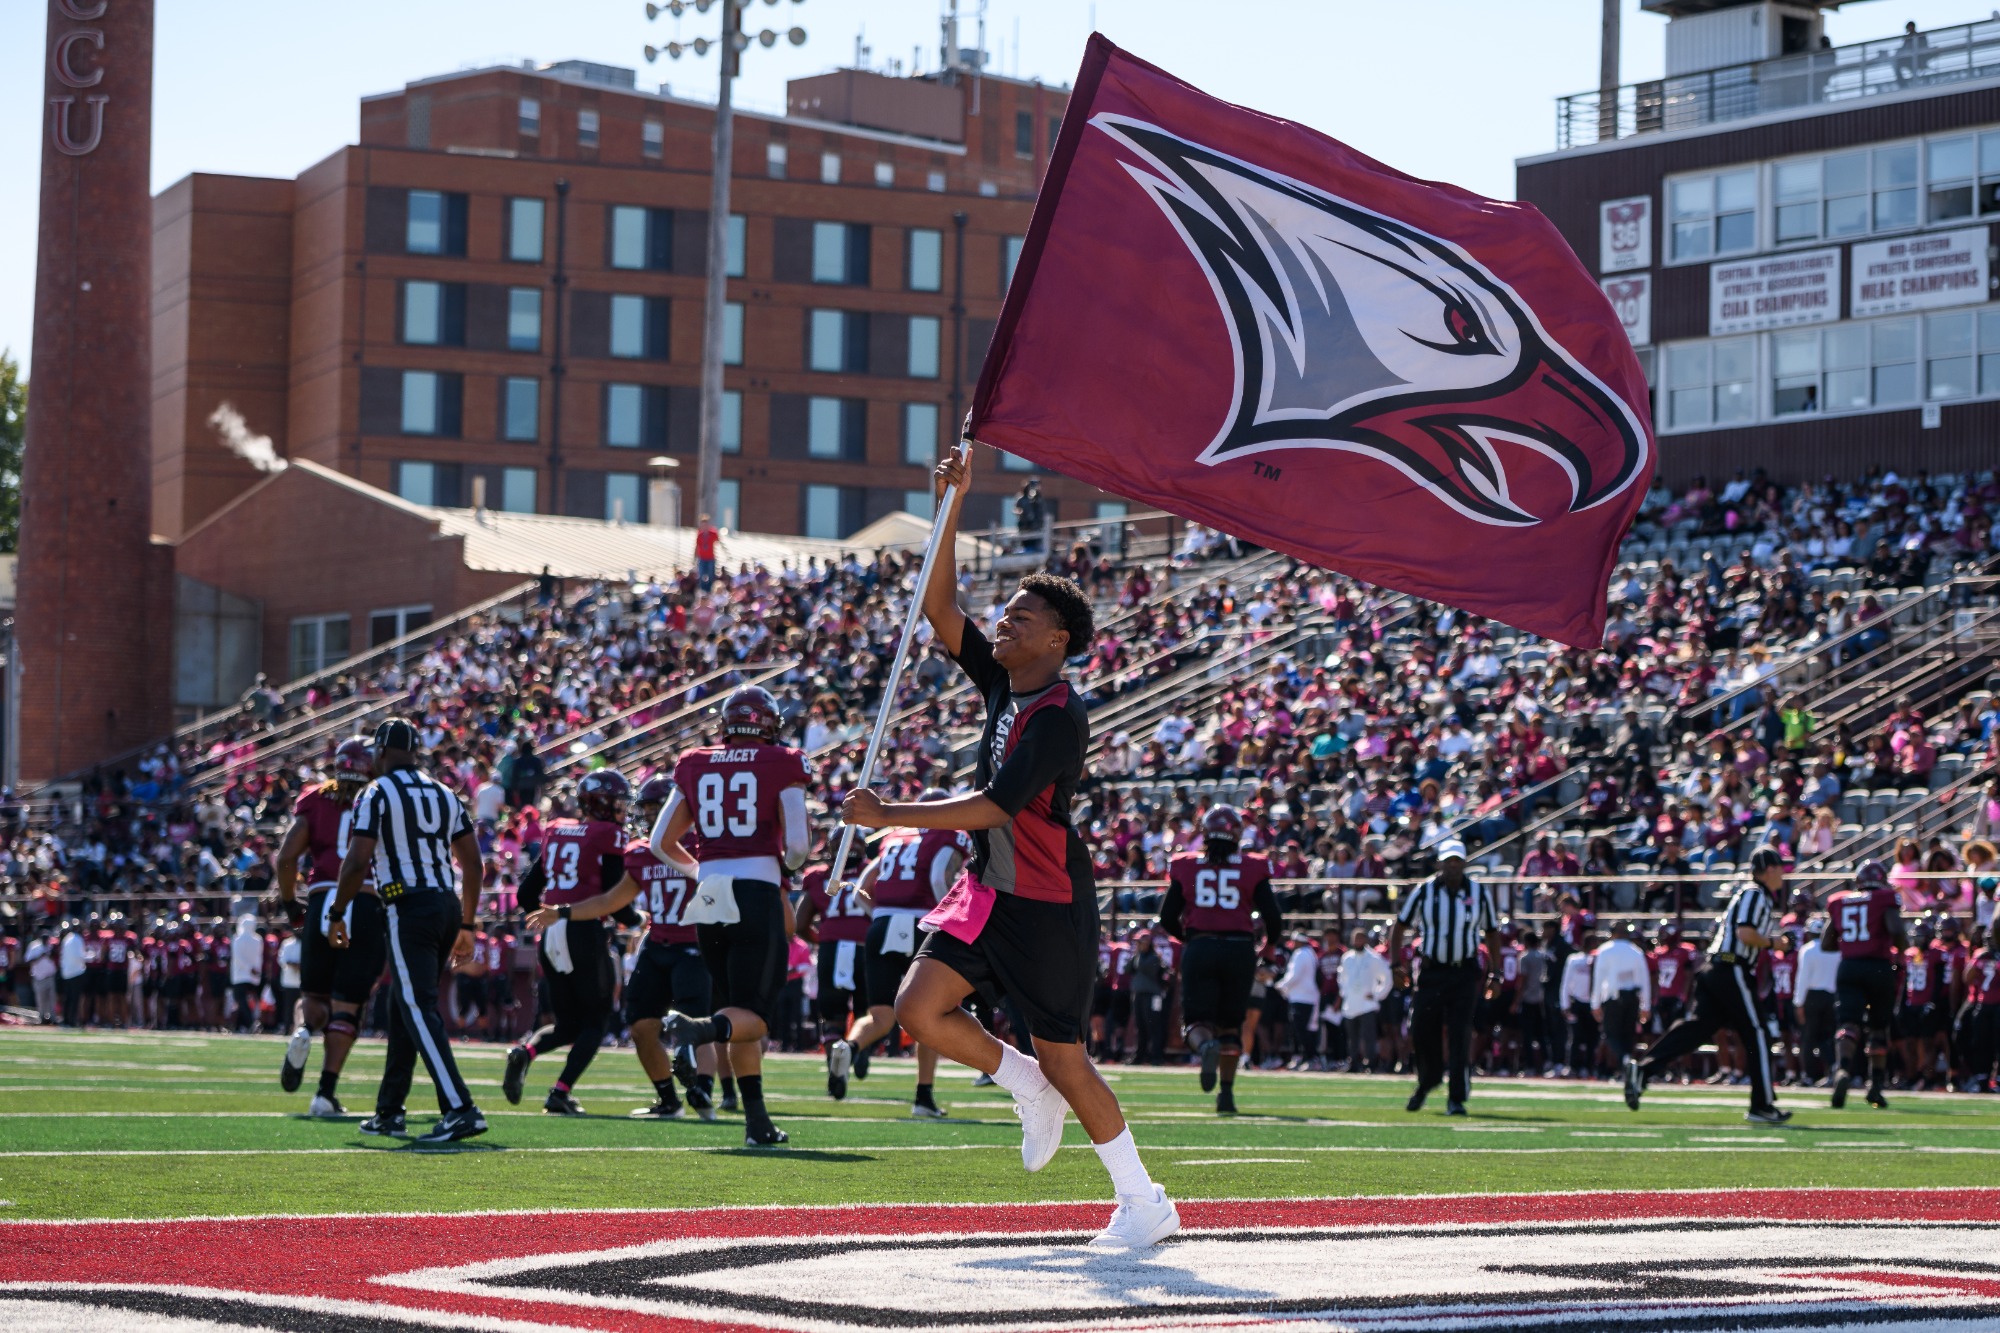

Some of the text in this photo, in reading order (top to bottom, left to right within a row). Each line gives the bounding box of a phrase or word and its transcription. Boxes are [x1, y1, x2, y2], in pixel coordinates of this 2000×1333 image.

[1755, 289, 1828, 315] CHAMPIONS
[1861, 268, 1979, 300] MEAC CHAMPIONS
[1253, 461, 1282, 481] TM
[737, 727, 761, 735] GREAT
[710, 748, 759, 763] BRACEY
[406, 787, 439, 834] U
[698, 771, 758, 838] 83
[545, 842, 581, 890] 13
[877, 836, 923, 881] 84
[650, 879, 687, 924] 47
[1195, 868, 1240, 909] 65
[1841, 904, 1870, 942] 51
